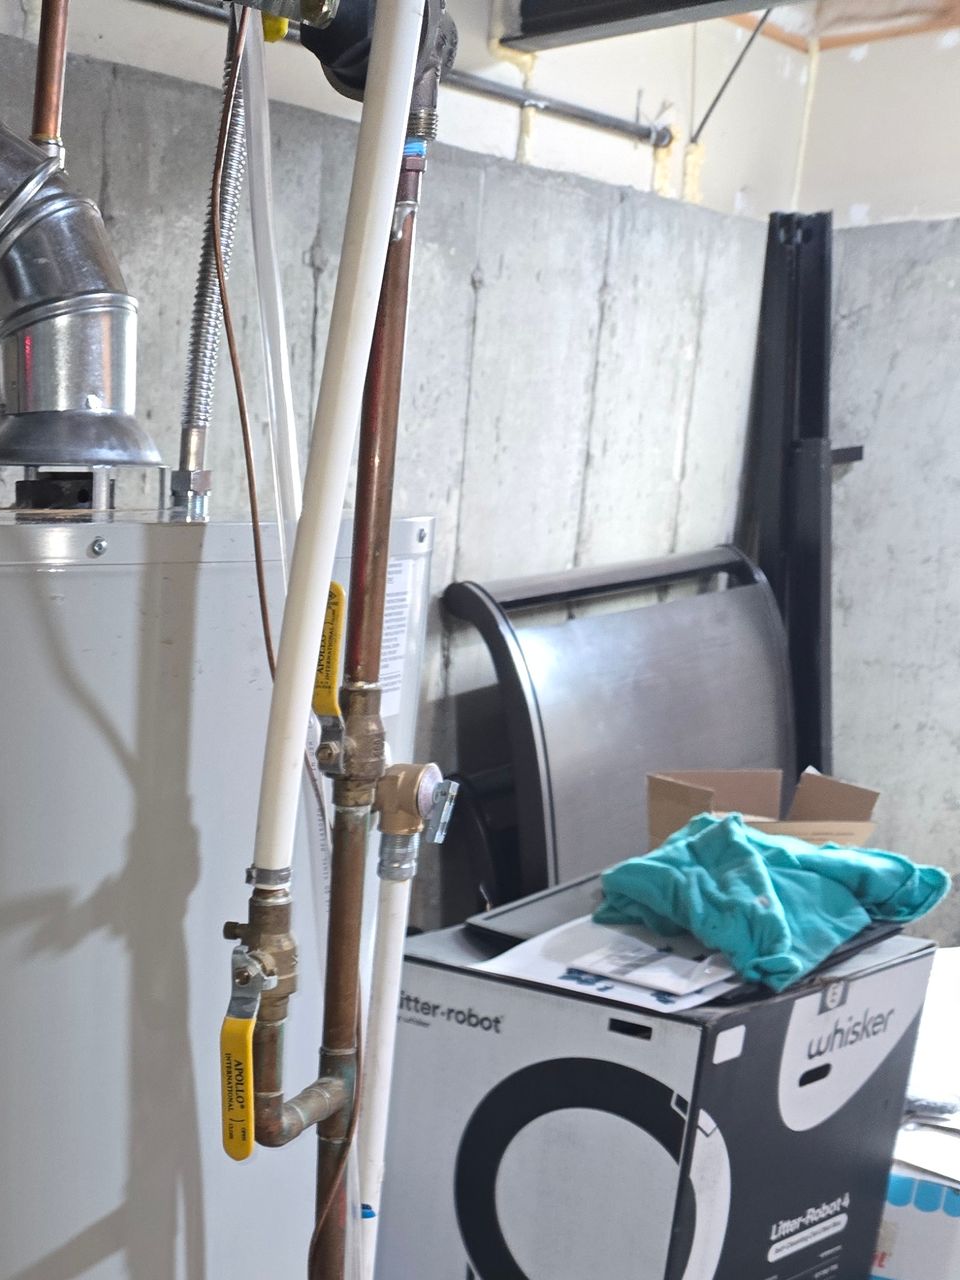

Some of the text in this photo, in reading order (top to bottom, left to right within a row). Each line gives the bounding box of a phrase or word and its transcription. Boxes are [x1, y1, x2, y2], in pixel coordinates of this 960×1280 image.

[399, 990, 502, 1034] itter-robot
[807, 1008, 895, 1060] whisker
[224, 1053, 234, 1112] INTERNATIONAL
[770, 1197, 842, 1241] Litter-Robot
[842, 1191, 850, 1208] 4
